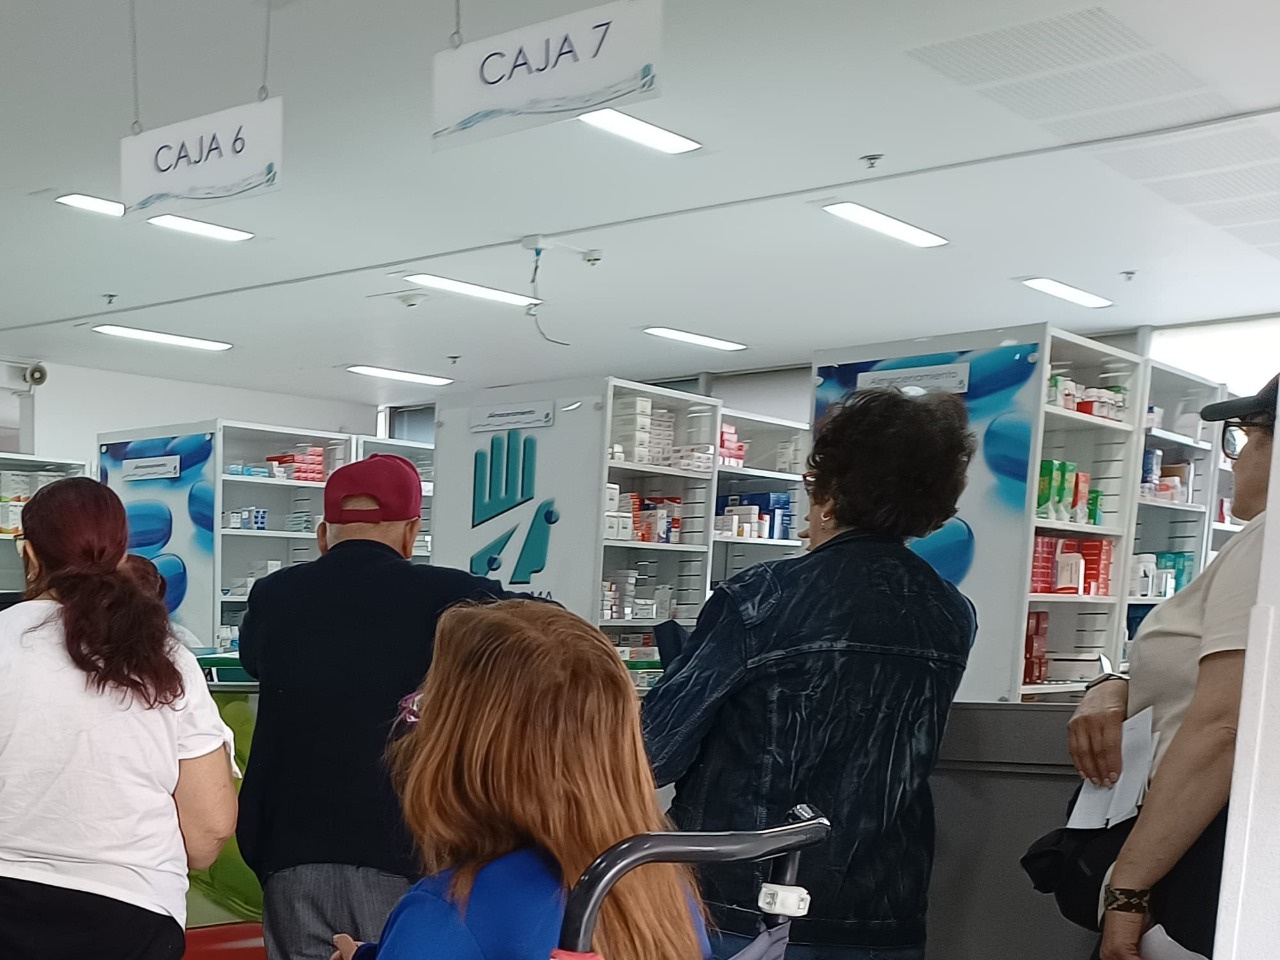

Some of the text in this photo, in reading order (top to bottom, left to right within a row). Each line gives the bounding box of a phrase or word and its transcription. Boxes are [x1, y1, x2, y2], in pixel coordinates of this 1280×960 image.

[479, 20, 613, 85] CAJA 7
[154, 124, 246, 173] CAJA 6
